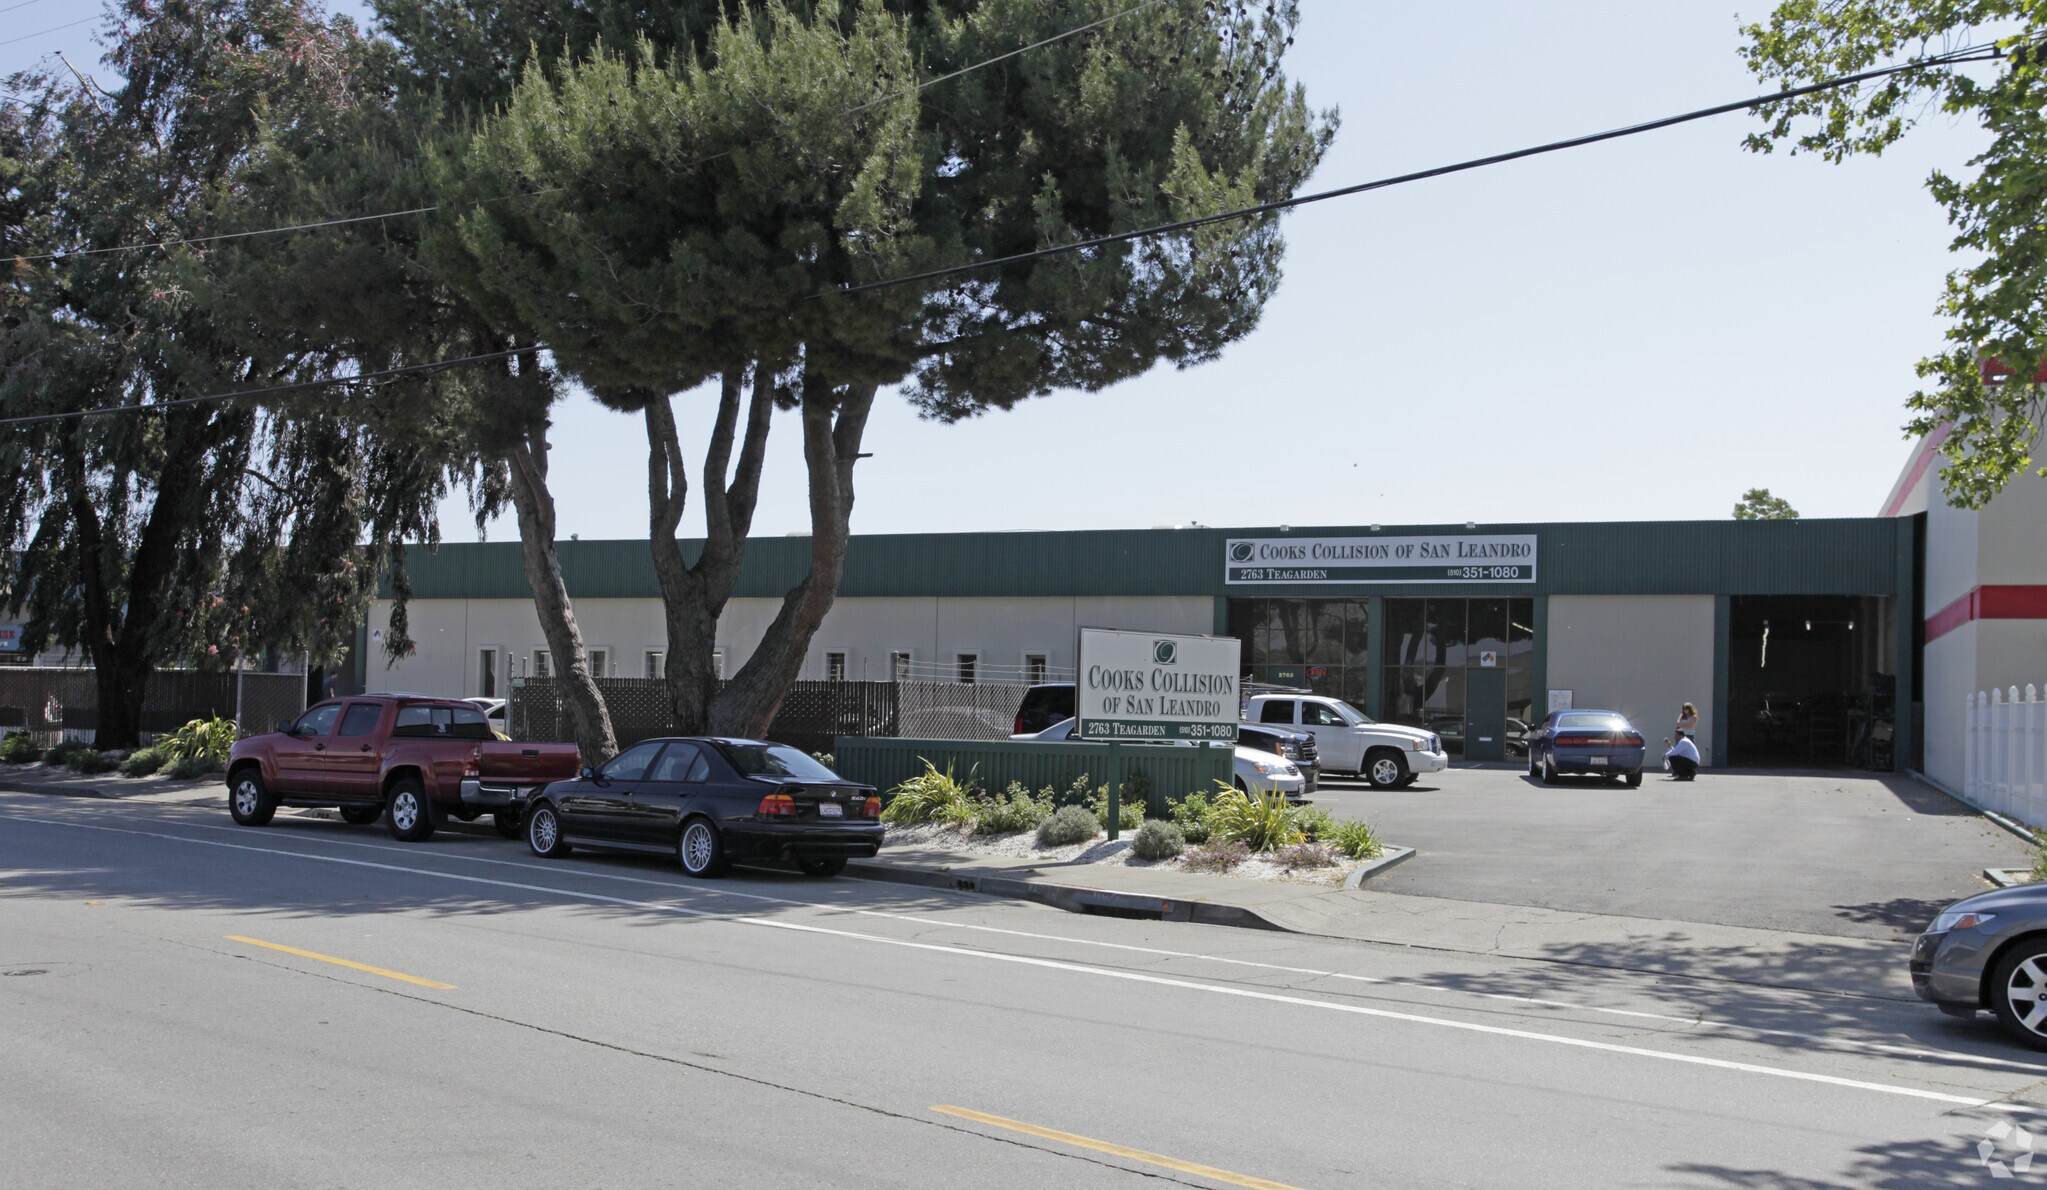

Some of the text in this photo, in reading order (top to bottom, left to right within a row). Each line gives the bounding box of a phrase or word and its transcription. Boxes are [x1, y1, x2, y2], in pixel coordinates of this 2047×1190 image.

[1260, 541, 1531, 560] COOKS COLLISION OF SAN LEANDRO
[1240, 568, 1328, 580] 2763 TEAGARDEN
[1462, 566, 1519, 578] 351-1080
[1089, 664, 1234, 695] COOKS COLLISION
[1103, 694, 1221, 717] OF SAN LEANDRO
[1088, 721, 1166, 736] 2763 TEAGARDEN
[1190, 723, 1232, 738] 351-1080
